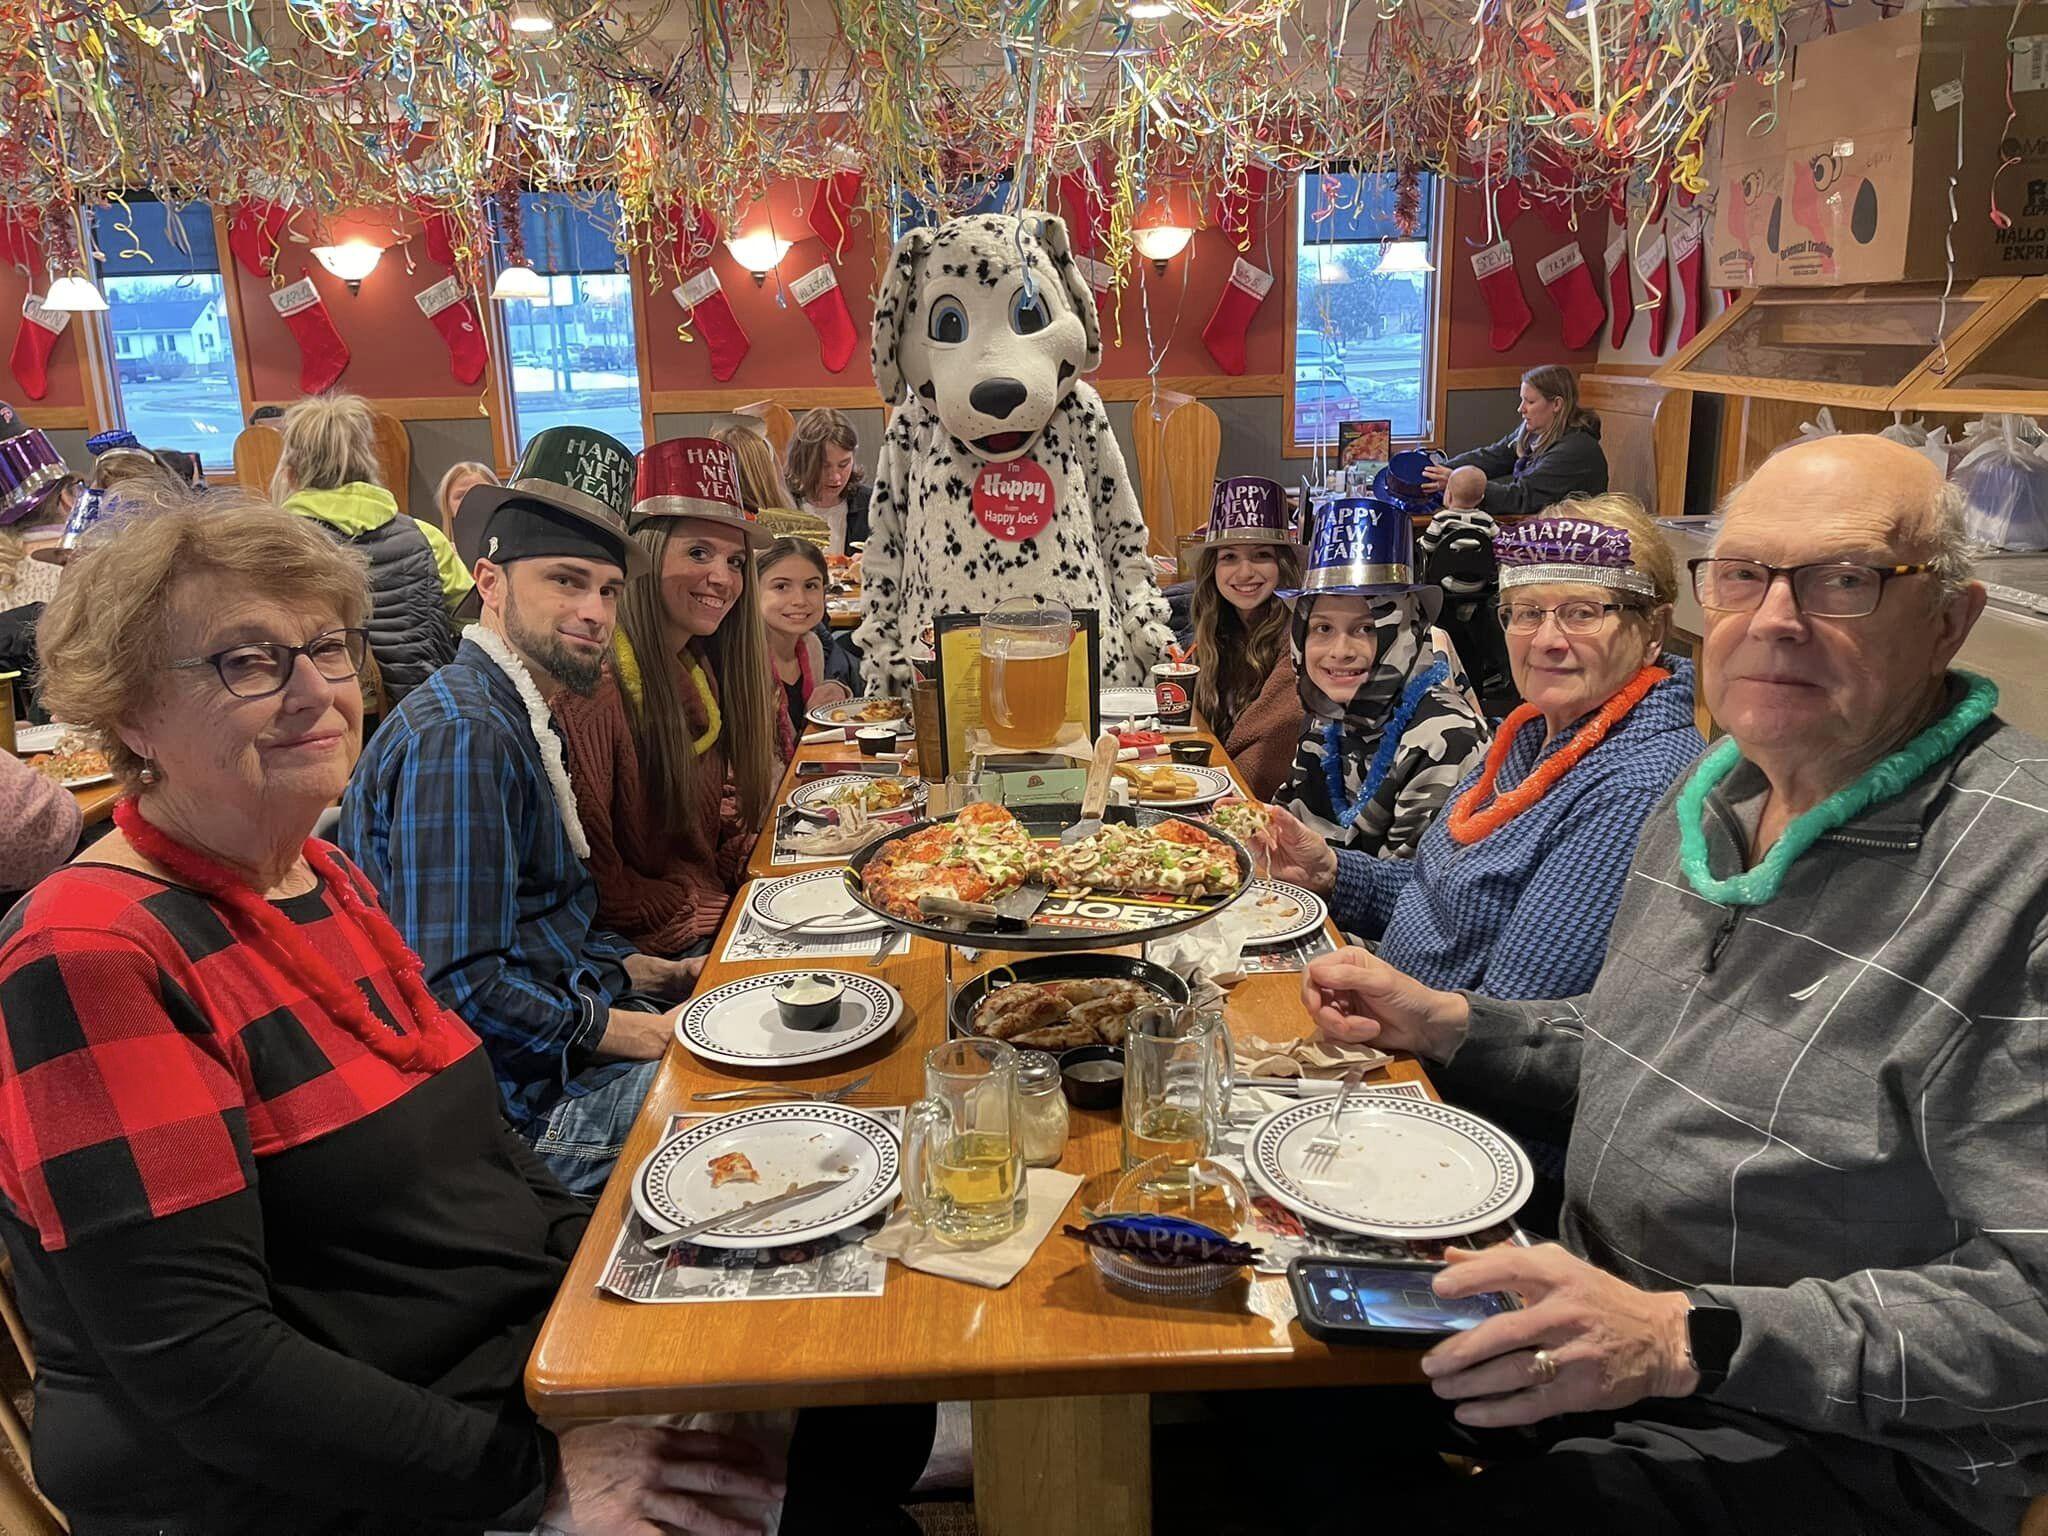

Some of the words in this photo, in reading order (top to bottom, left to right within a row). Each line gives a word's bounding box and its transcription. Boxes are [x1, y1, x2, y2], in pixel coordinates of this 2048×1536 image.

[1780, 241, 1807, 261] Oriental
[1808, 241, 1834, 258] Trading
[576, 456, 627, 493] NEW
[1008, 463, 1020, 472] I'm
[981, 473, 1046, 504] Happy
[1216, 485, 1270, 506] HAPPY
[984, 509, 1015, 525] Happy
[1016, 512, 1039, 525] Joe's
[1221, 498, 1259, 517] NEW
[1216, 512, 1265, 531] YEAR!
[1315, 507, 1383, 535] HAPPY
[1320, 525, 1368, 547] NEW
[1518, 520, 1609, 545] HAPPY
[1314, 542, 1373, 565] YEAR!
[1050, 917, 1112, 929] CREAM
